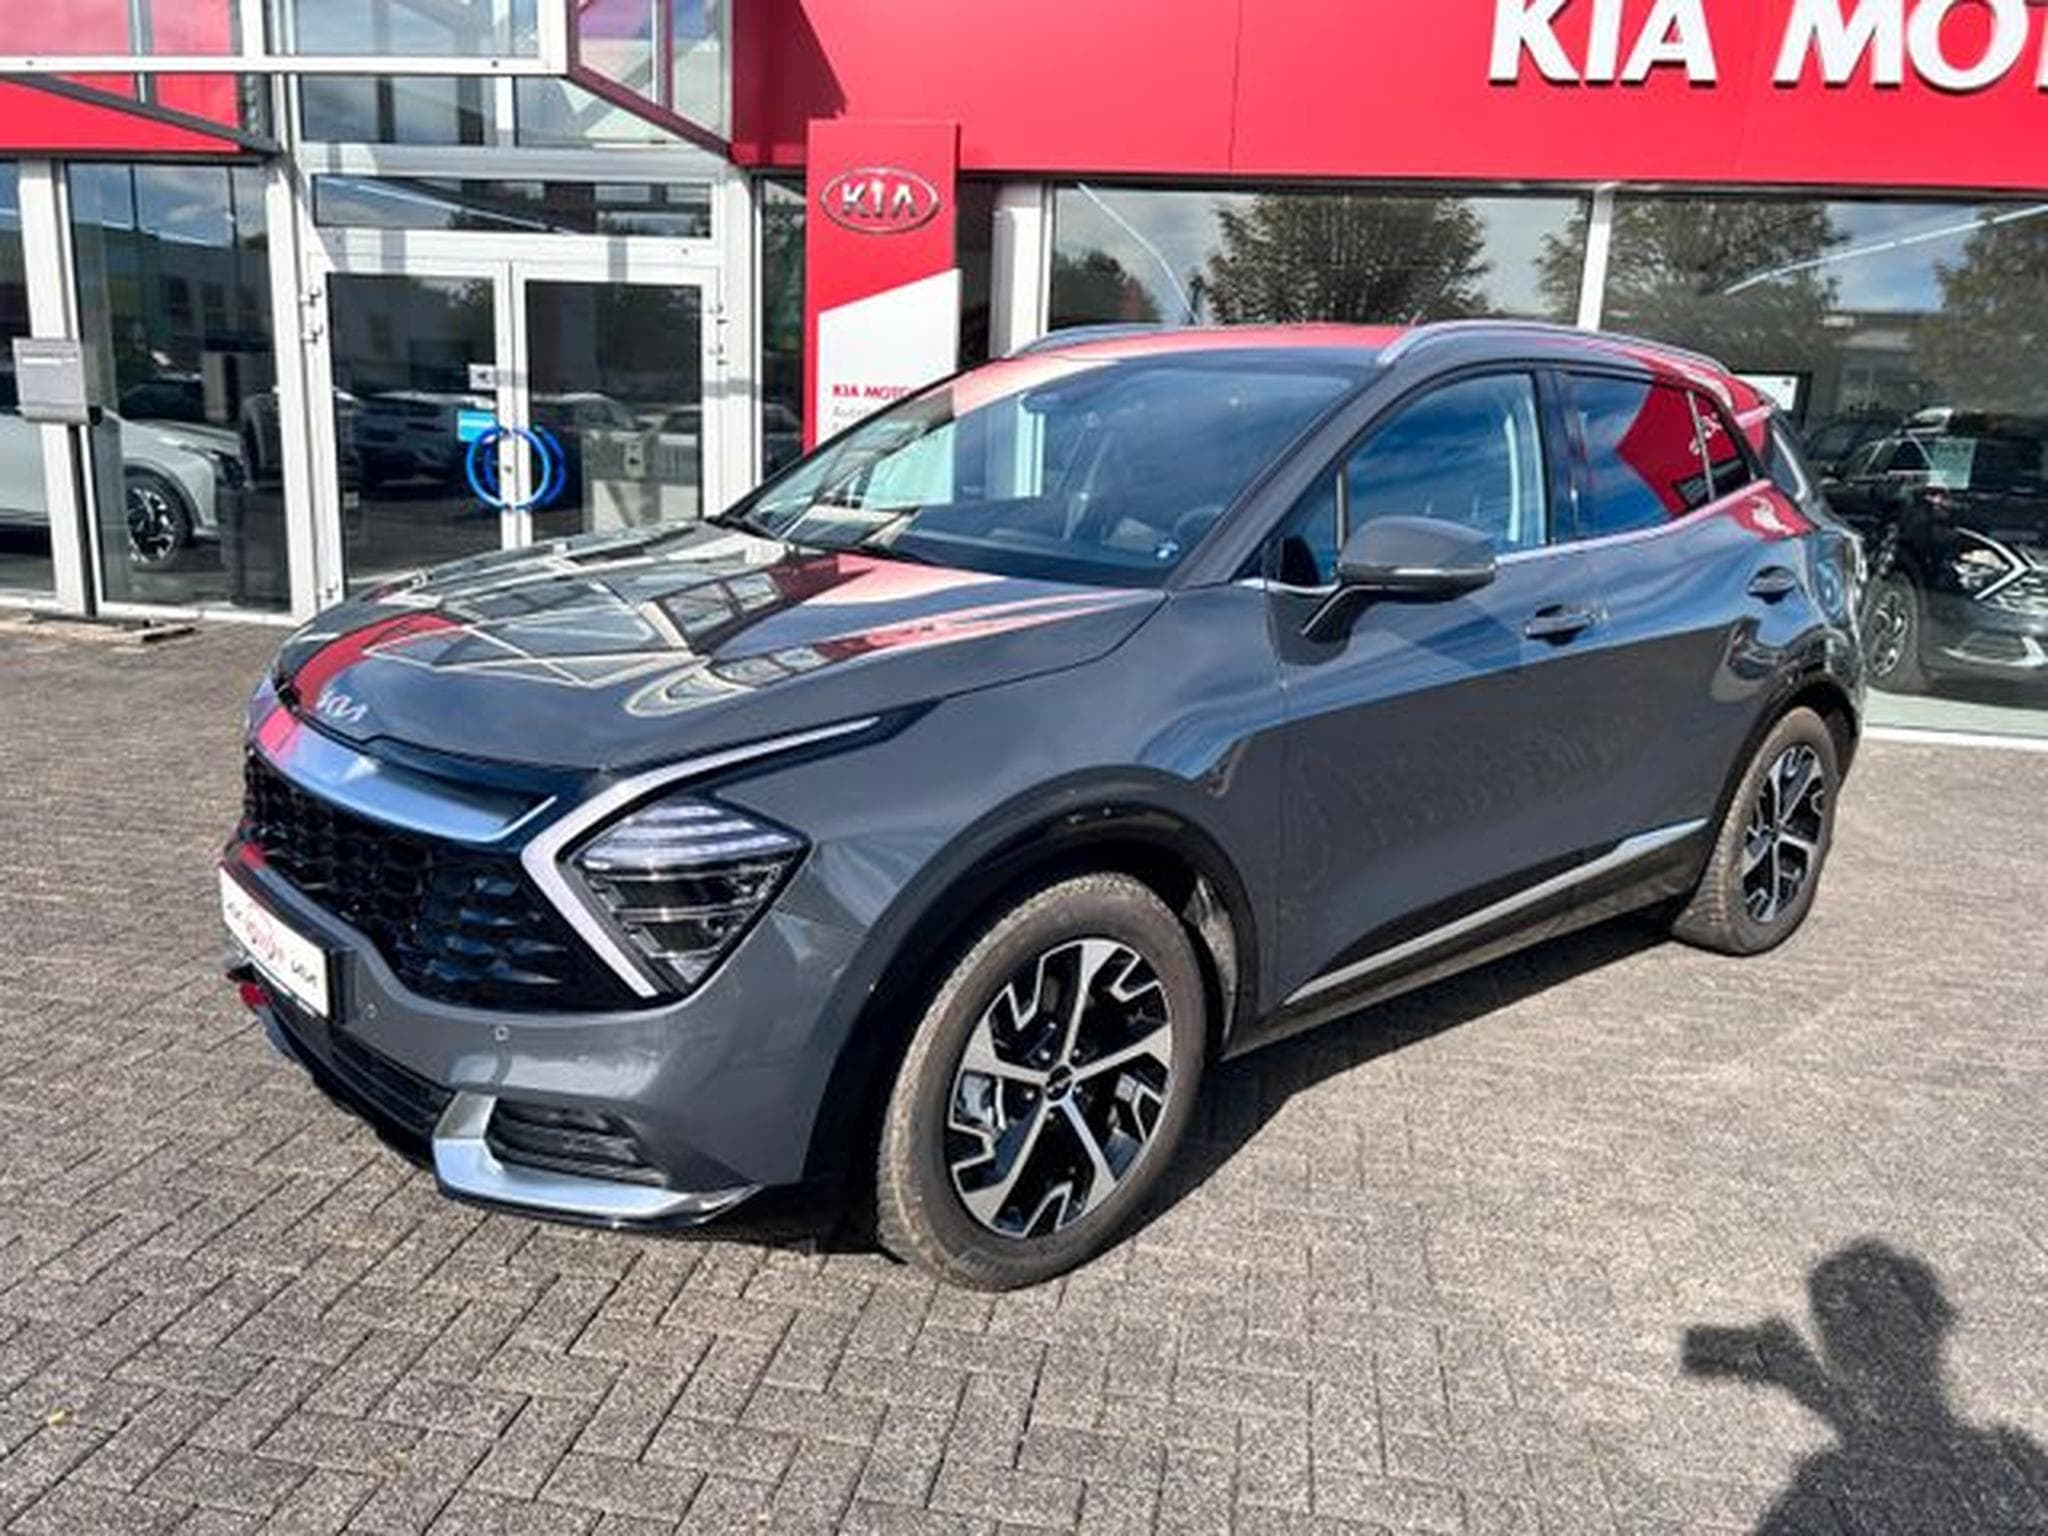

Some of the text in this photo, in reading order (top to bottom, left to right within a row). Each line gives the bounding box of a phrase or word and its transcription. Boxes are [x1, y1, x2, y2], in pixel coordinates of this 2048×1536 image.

[1489, 0, 1718, 85] KIA
[842, 181, 917, 217] KIA
[832, 384, 859, 398] KIA
